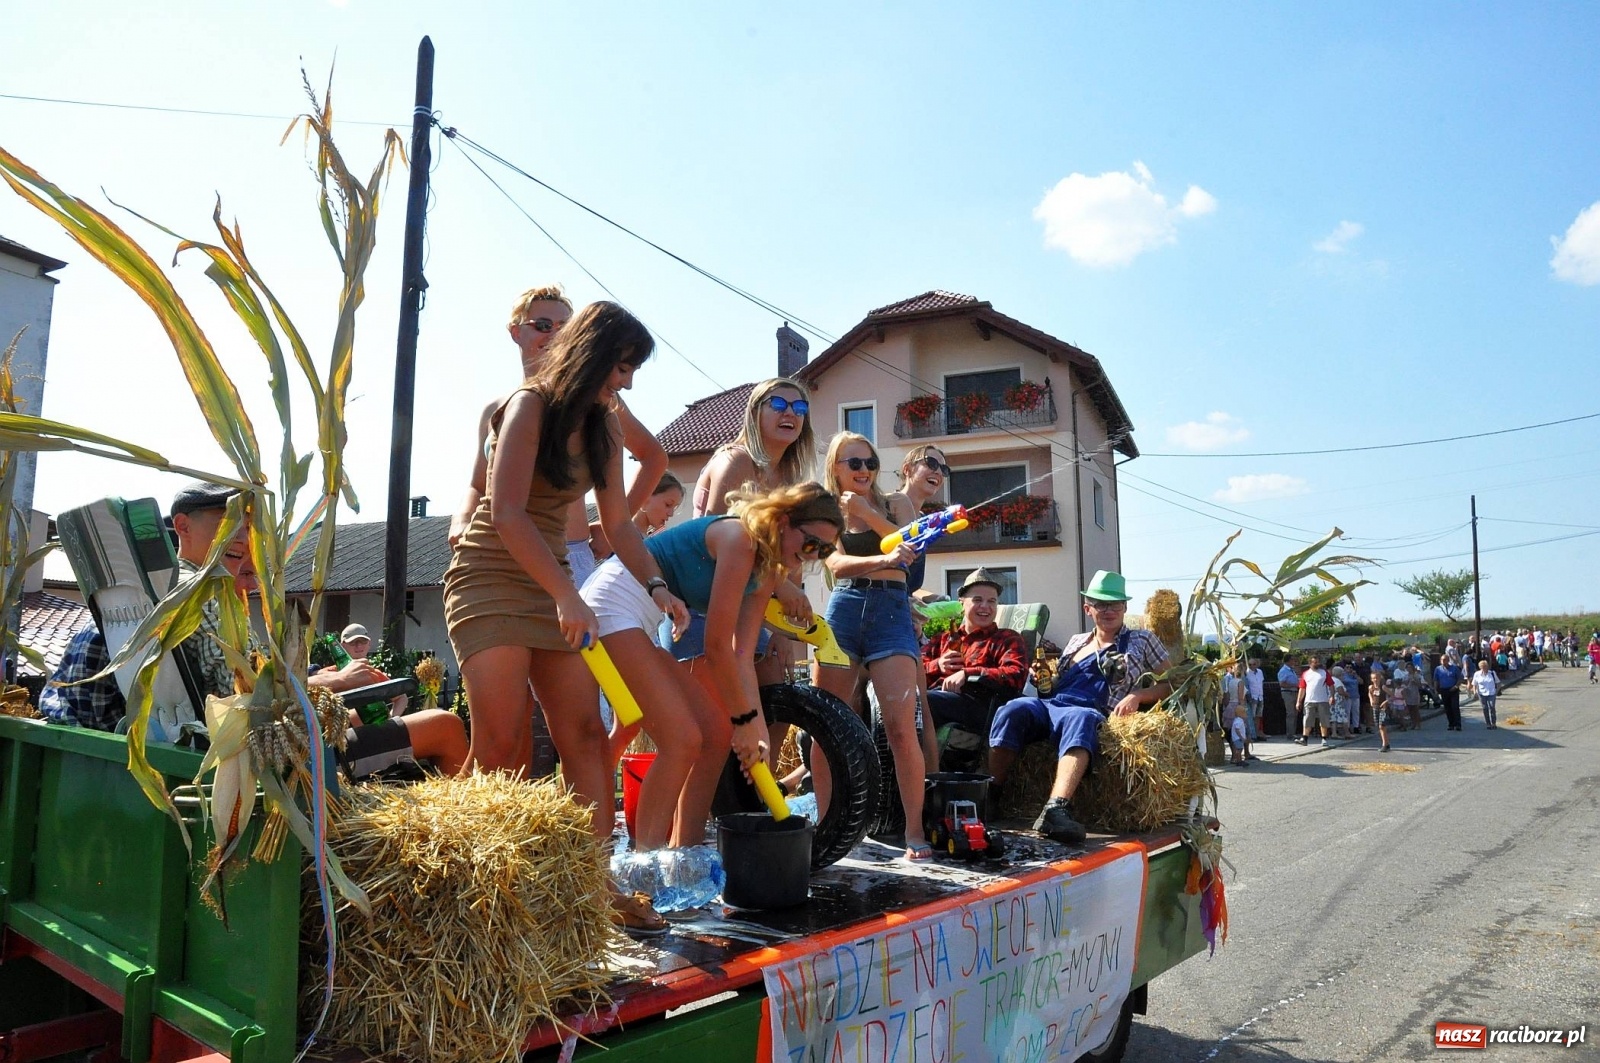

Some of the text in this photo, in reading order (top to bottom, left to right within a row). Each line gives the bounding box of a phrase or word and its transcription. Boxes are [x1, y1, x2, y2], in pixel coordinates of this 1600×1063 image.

[778, 932, 903, 1035] NIGDZIE
[912, 922, 951, 993] NA
[1043, 881, 1072, 941] NIE
[979, 925, 1122, 1045] TRAKTOR-MYJNI
